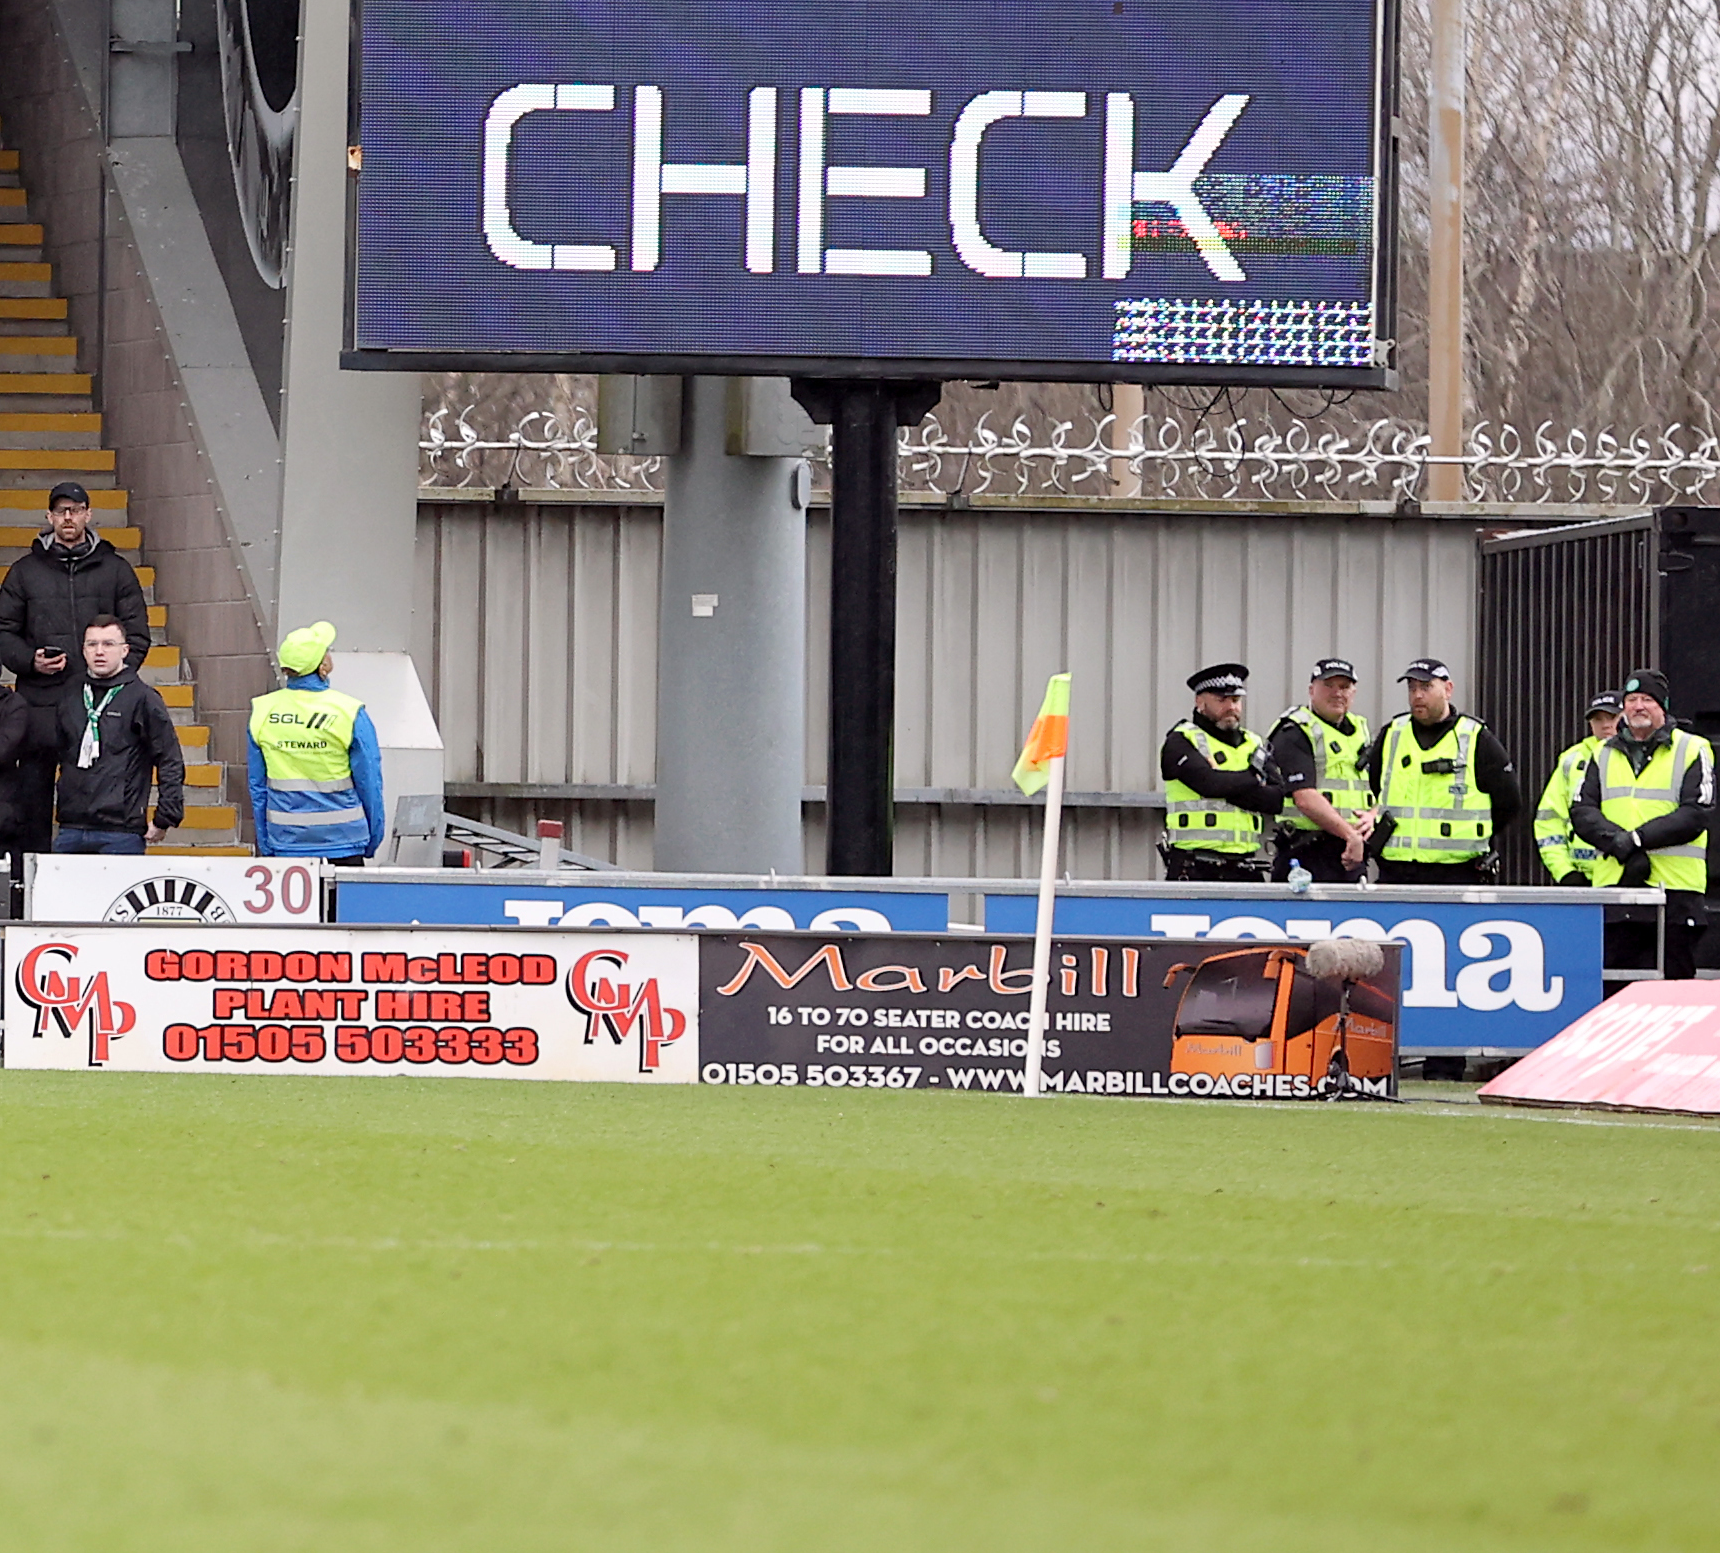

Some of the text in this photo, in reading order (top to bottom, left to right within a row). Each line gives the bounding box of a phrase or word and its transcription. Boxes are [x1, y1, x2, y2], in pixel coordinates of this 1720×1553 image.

[482, 83, 1250, 282] CHECK
[269, 713, 305, 725] SGL
[276, 741, 327, 749] STEWARD
[243, 865, 312, 915] 30
[156, 906, 183, 916] 1877
[145, 949, 558, 986] GORDON McLEOD
[716, 942, 1140, 996] Marbill
[214, 988, 492, 1023] PLANT HIRE
[767, 1006, 1112, 1032] 16 TO 70 SEATER COAC HIRE
[163, 1024, 540, 1066] 01505 503333
[817, 1034, 865, 1054] FOR
[869, 1036, 914, 1055] ALL
[702, 1062, 799, 1086] 01505
[806, 1065, 923, 1089] 503367
